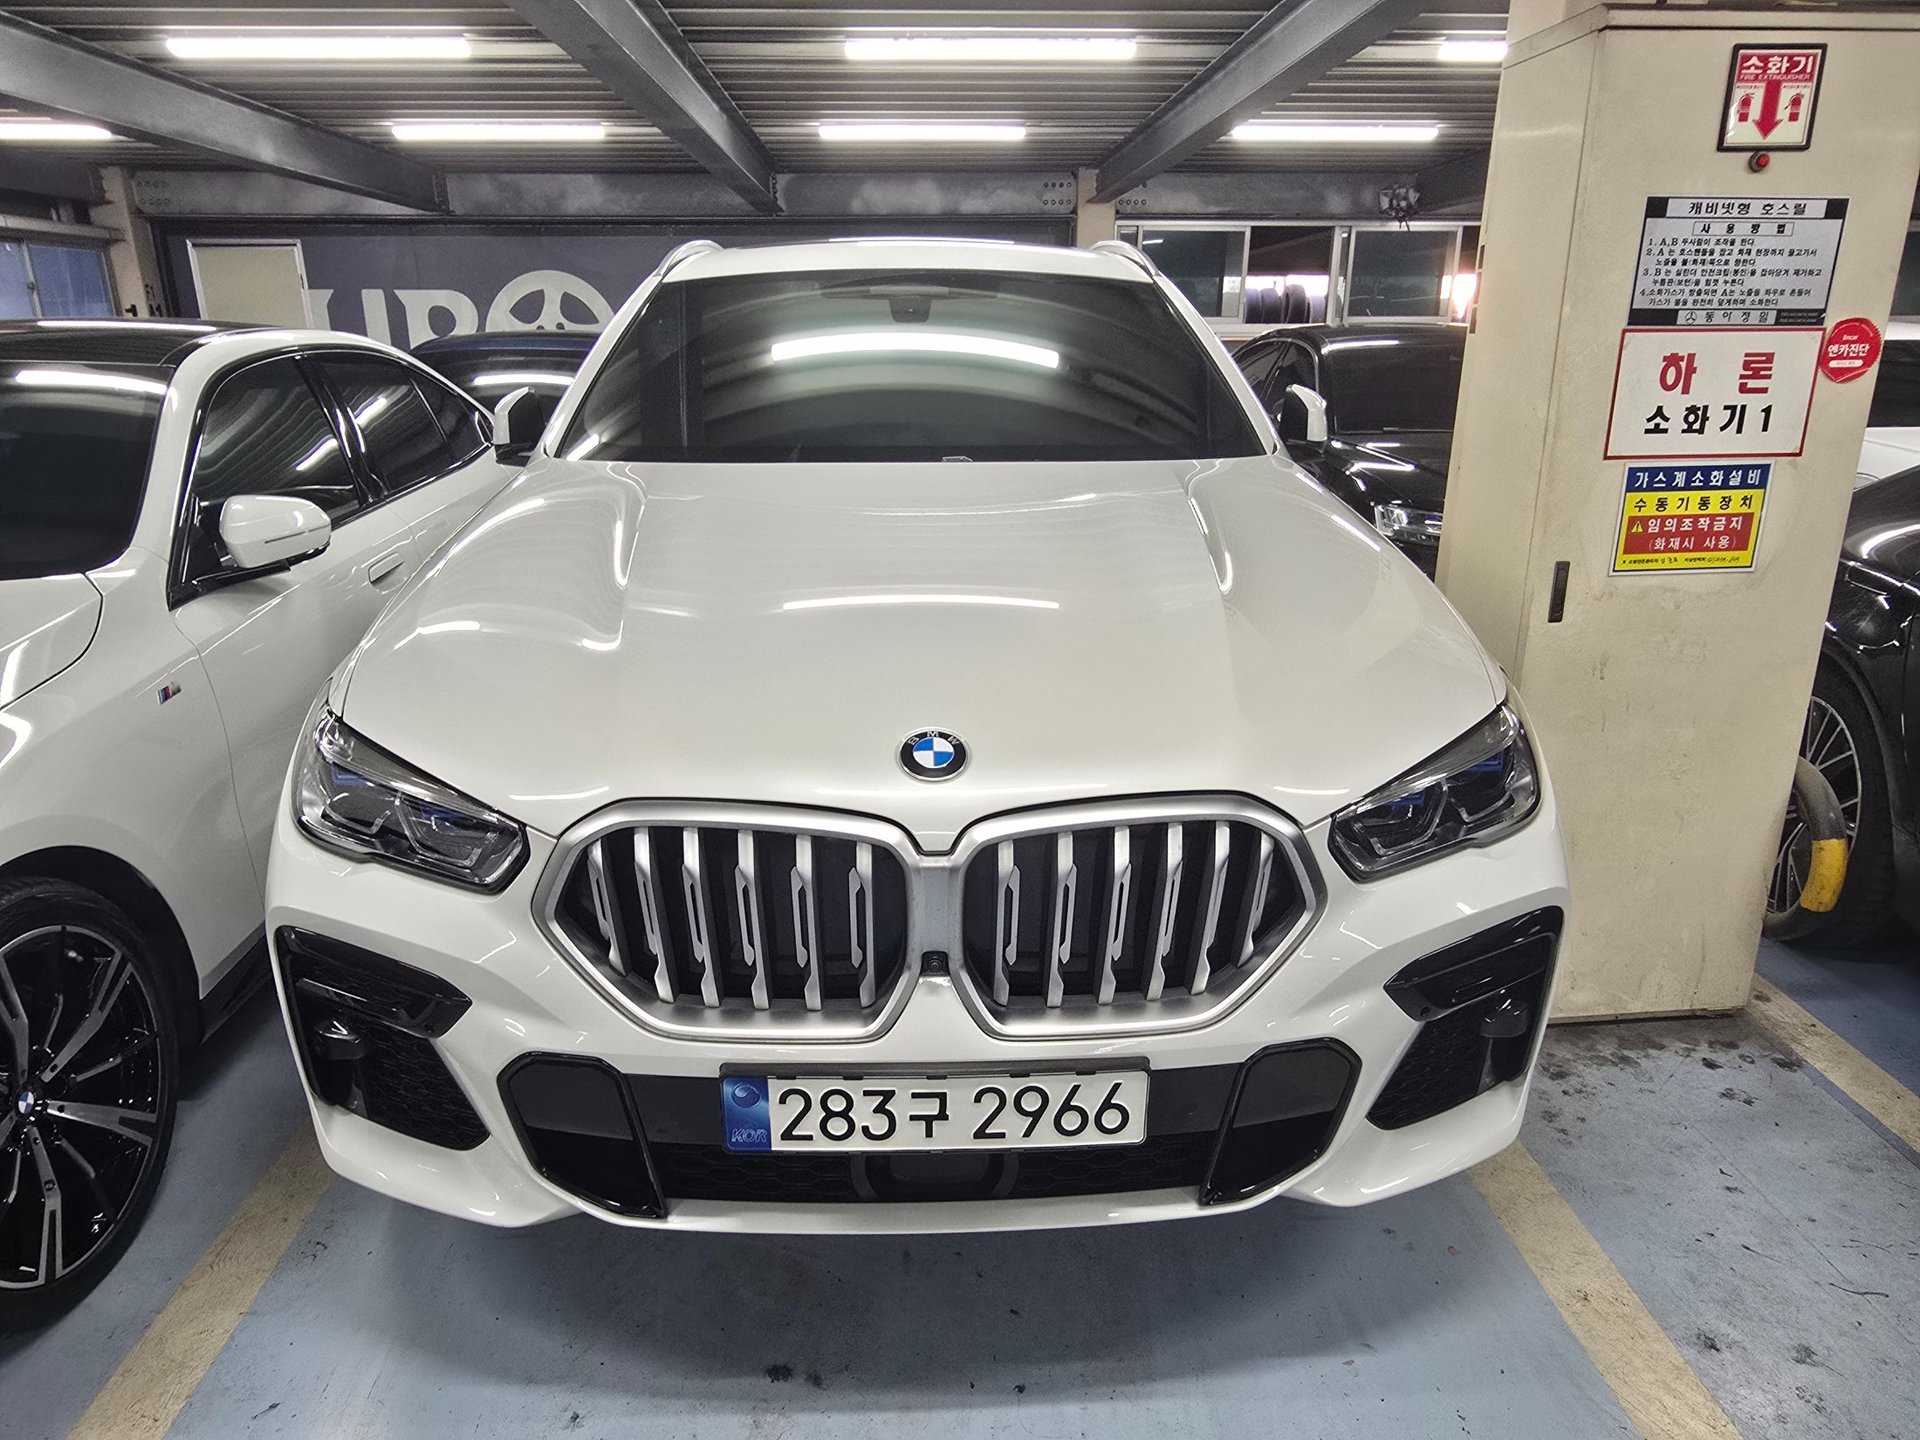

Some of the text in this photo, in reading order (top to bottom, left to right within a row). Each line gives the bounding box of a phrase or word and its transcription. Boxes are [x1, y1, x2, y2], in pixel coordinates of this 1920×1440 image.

[1741, 55, 1814, 74] 소화기
[1688, 201, 1807, 216] 캐비넷형 호스릴
[1828, 343, 1870, 357] 엔카진단
[1635, 469, 1761, 489] 가스계소화설비
[1634, 494, 1753, 512] 수동기동장치
[1648, 516, 1743, 533] 임의조작금지
[907, 731, 960, 745] BMW
[778, 1082, 1131, 1142] 283구 2966
[731, 1129, 768, 1143] KOR
